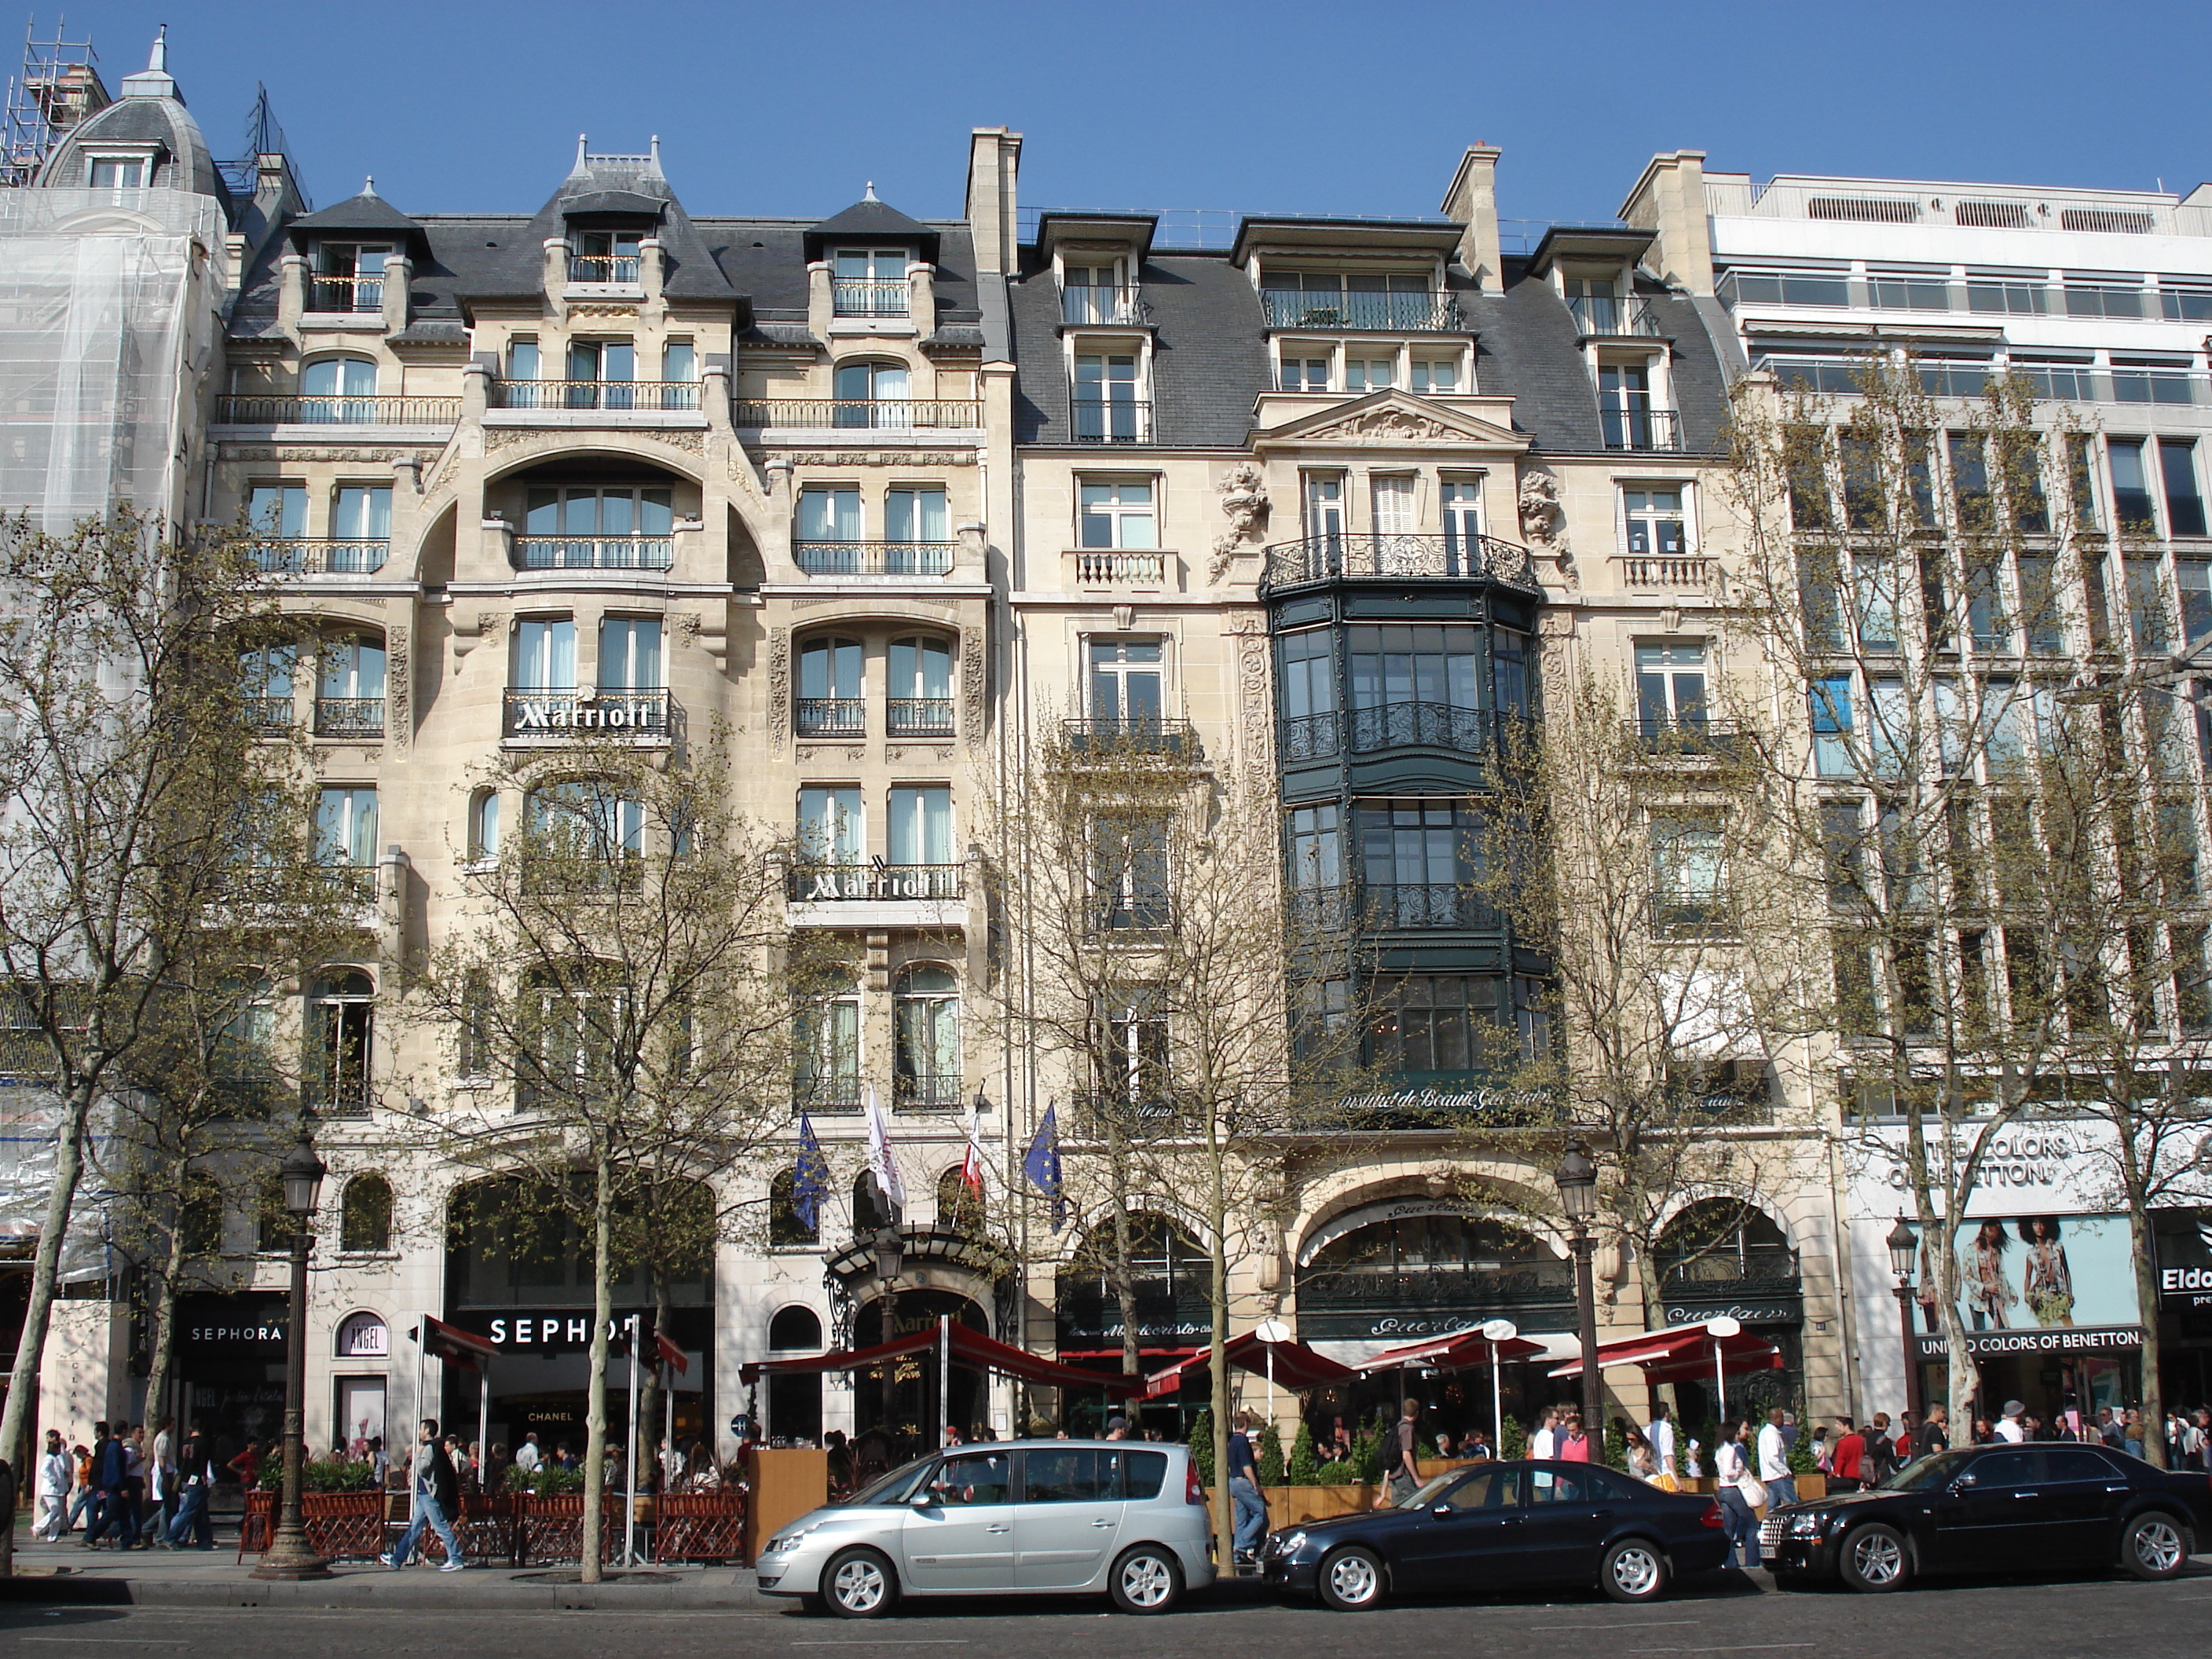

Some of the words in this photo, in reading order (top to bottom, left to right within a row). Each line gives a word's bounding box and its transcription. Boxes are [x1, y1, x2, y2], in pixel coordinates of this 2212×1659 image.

[514, 702, 649, 729] Marriott
[806, 873, 947, 899] Marriott
[1397, 1090, 1417, 1108] de
[192, 1328, 282, 1340] SEPHORA
[1372, 1317, 1486, 1335] Guerlai
[350, 1328, 379, 1350] ANGEL
[1922, 1339, 1976, 1354] UNID
[1979, 1336, 2037, 1352] COLORS
[2040, 1335, 2060, 1349] OF
